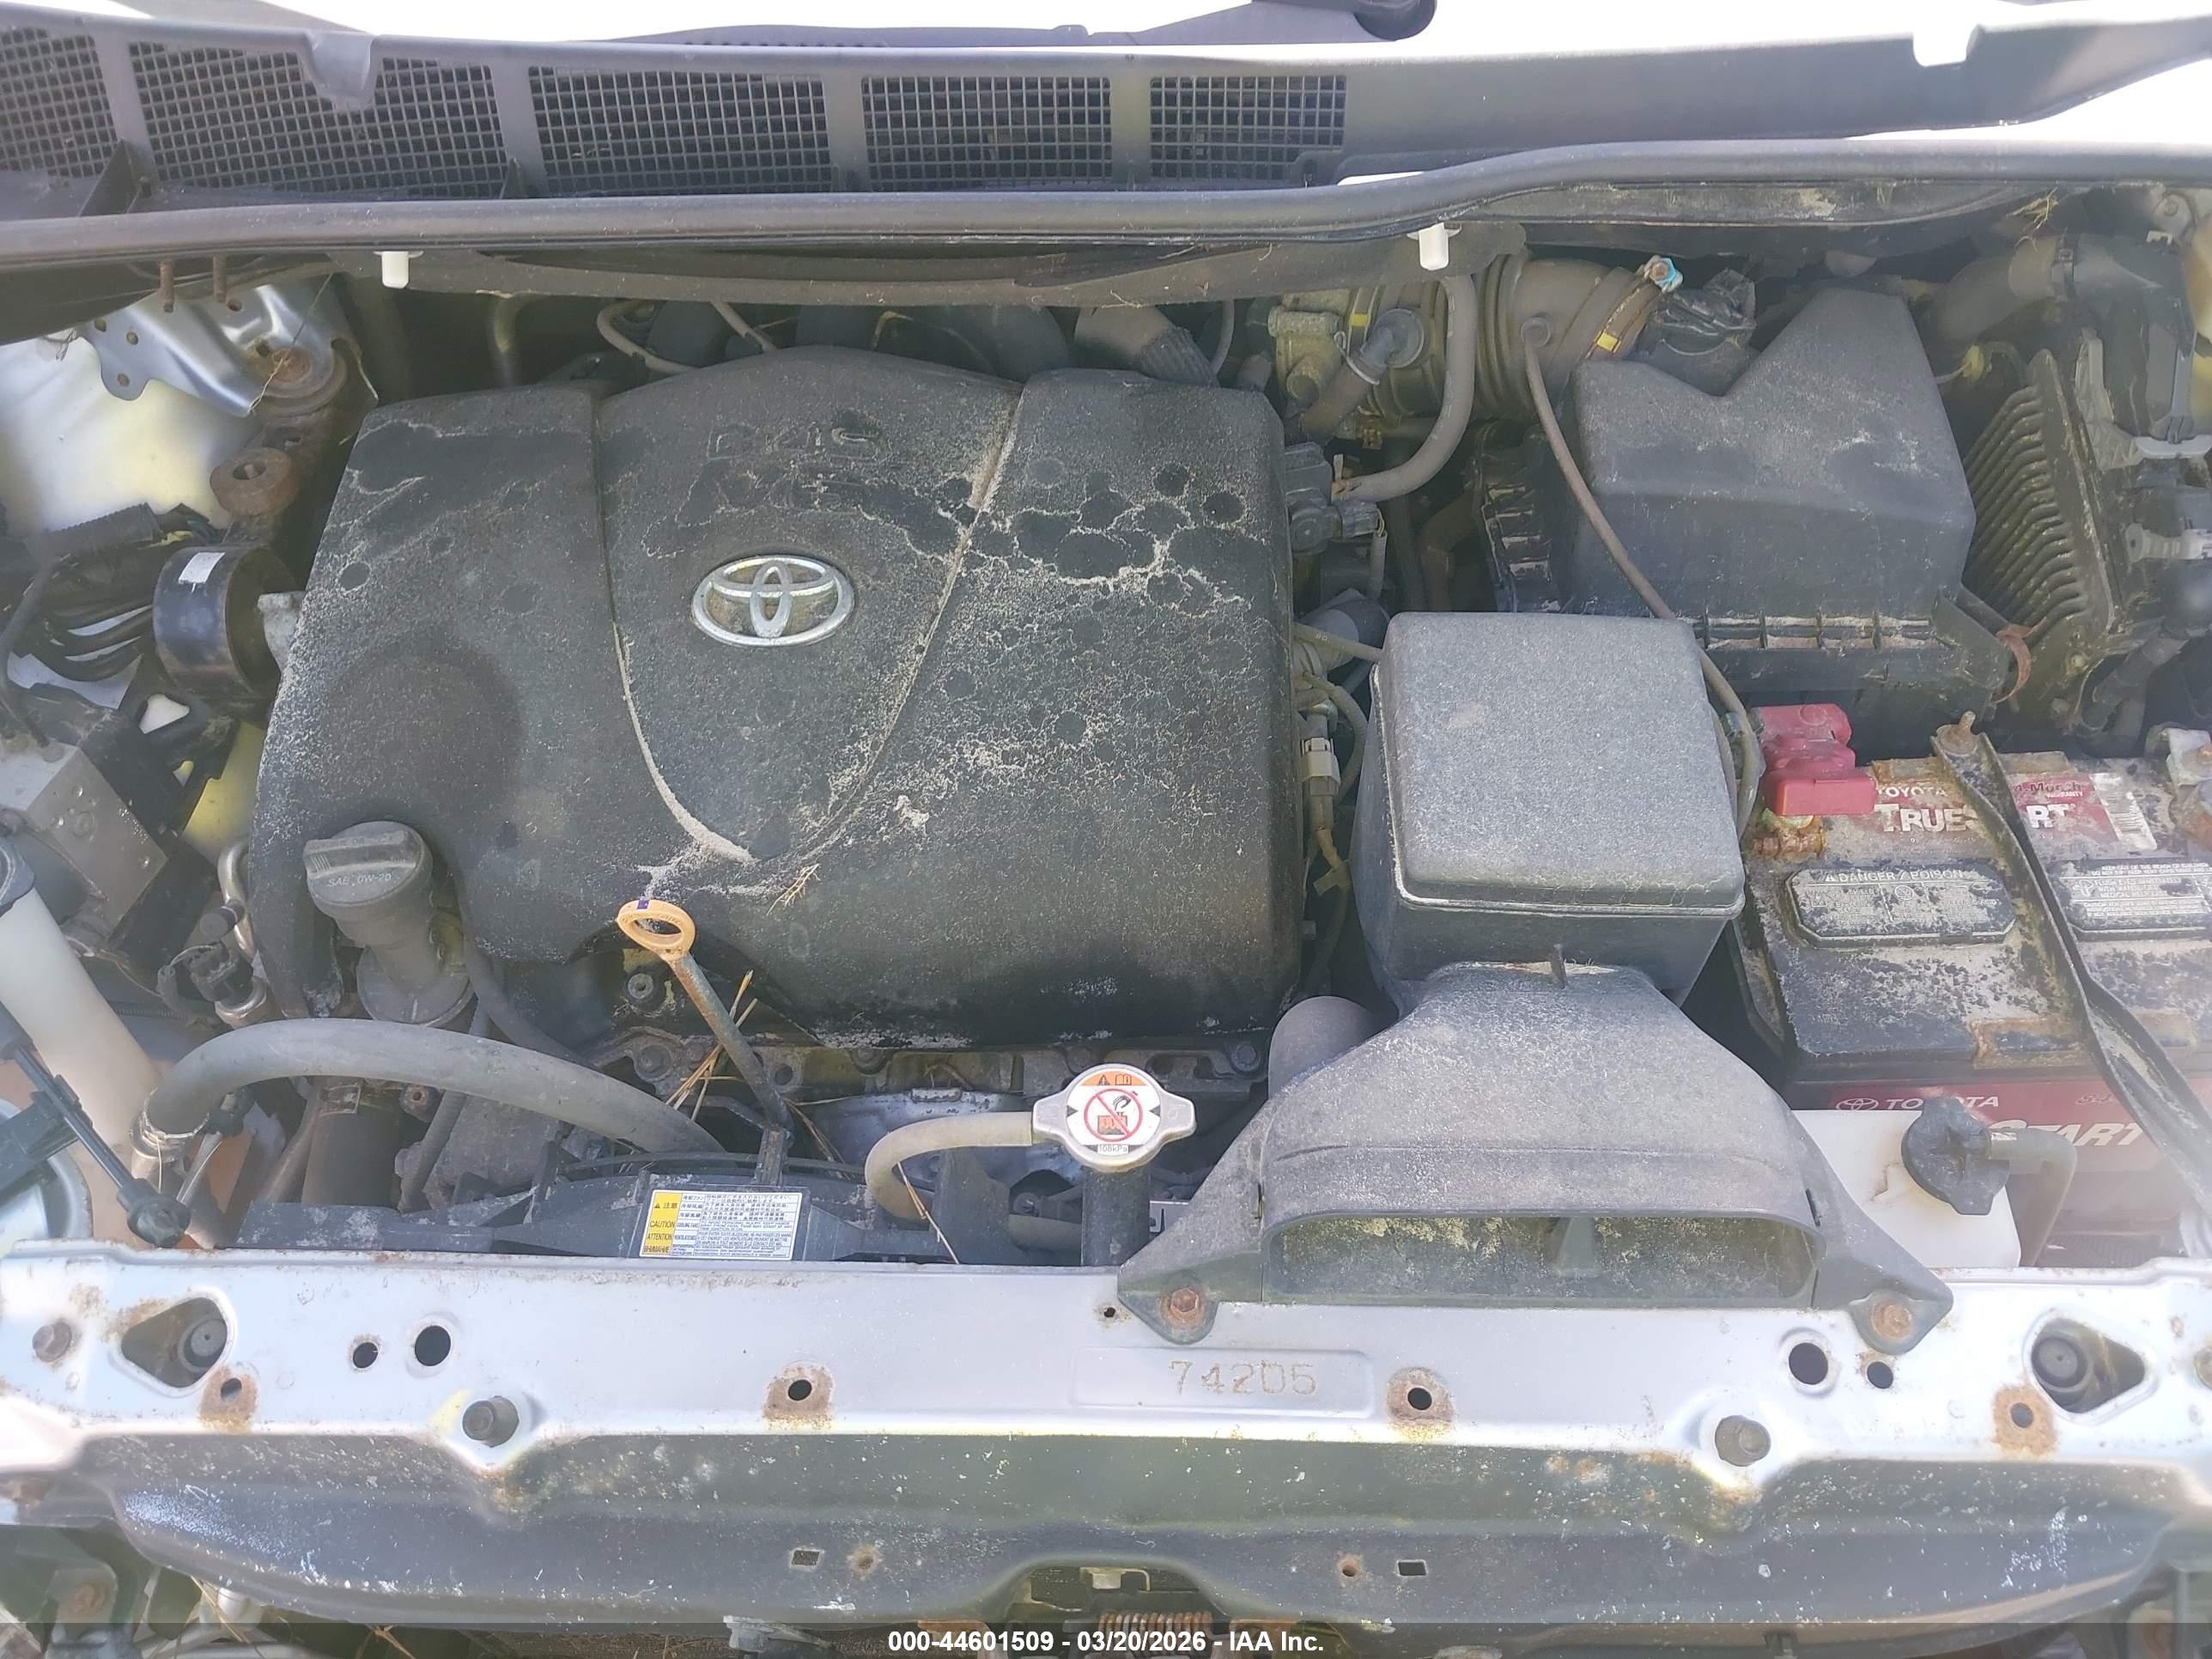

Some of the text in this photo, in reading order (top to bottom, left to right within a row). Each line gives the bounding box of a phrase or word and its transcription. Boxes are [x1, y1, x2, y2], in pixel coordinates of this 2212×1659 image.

[327, 872, 392, 887] SAE 0W-20
[1838, 872, 1896, 883] DANGER
[1910, 870, 1963, 880] POISON
[1886, 1096, 1999, 1109] TOTA
[1098, 1144, 1127, 1152] 108kPa
